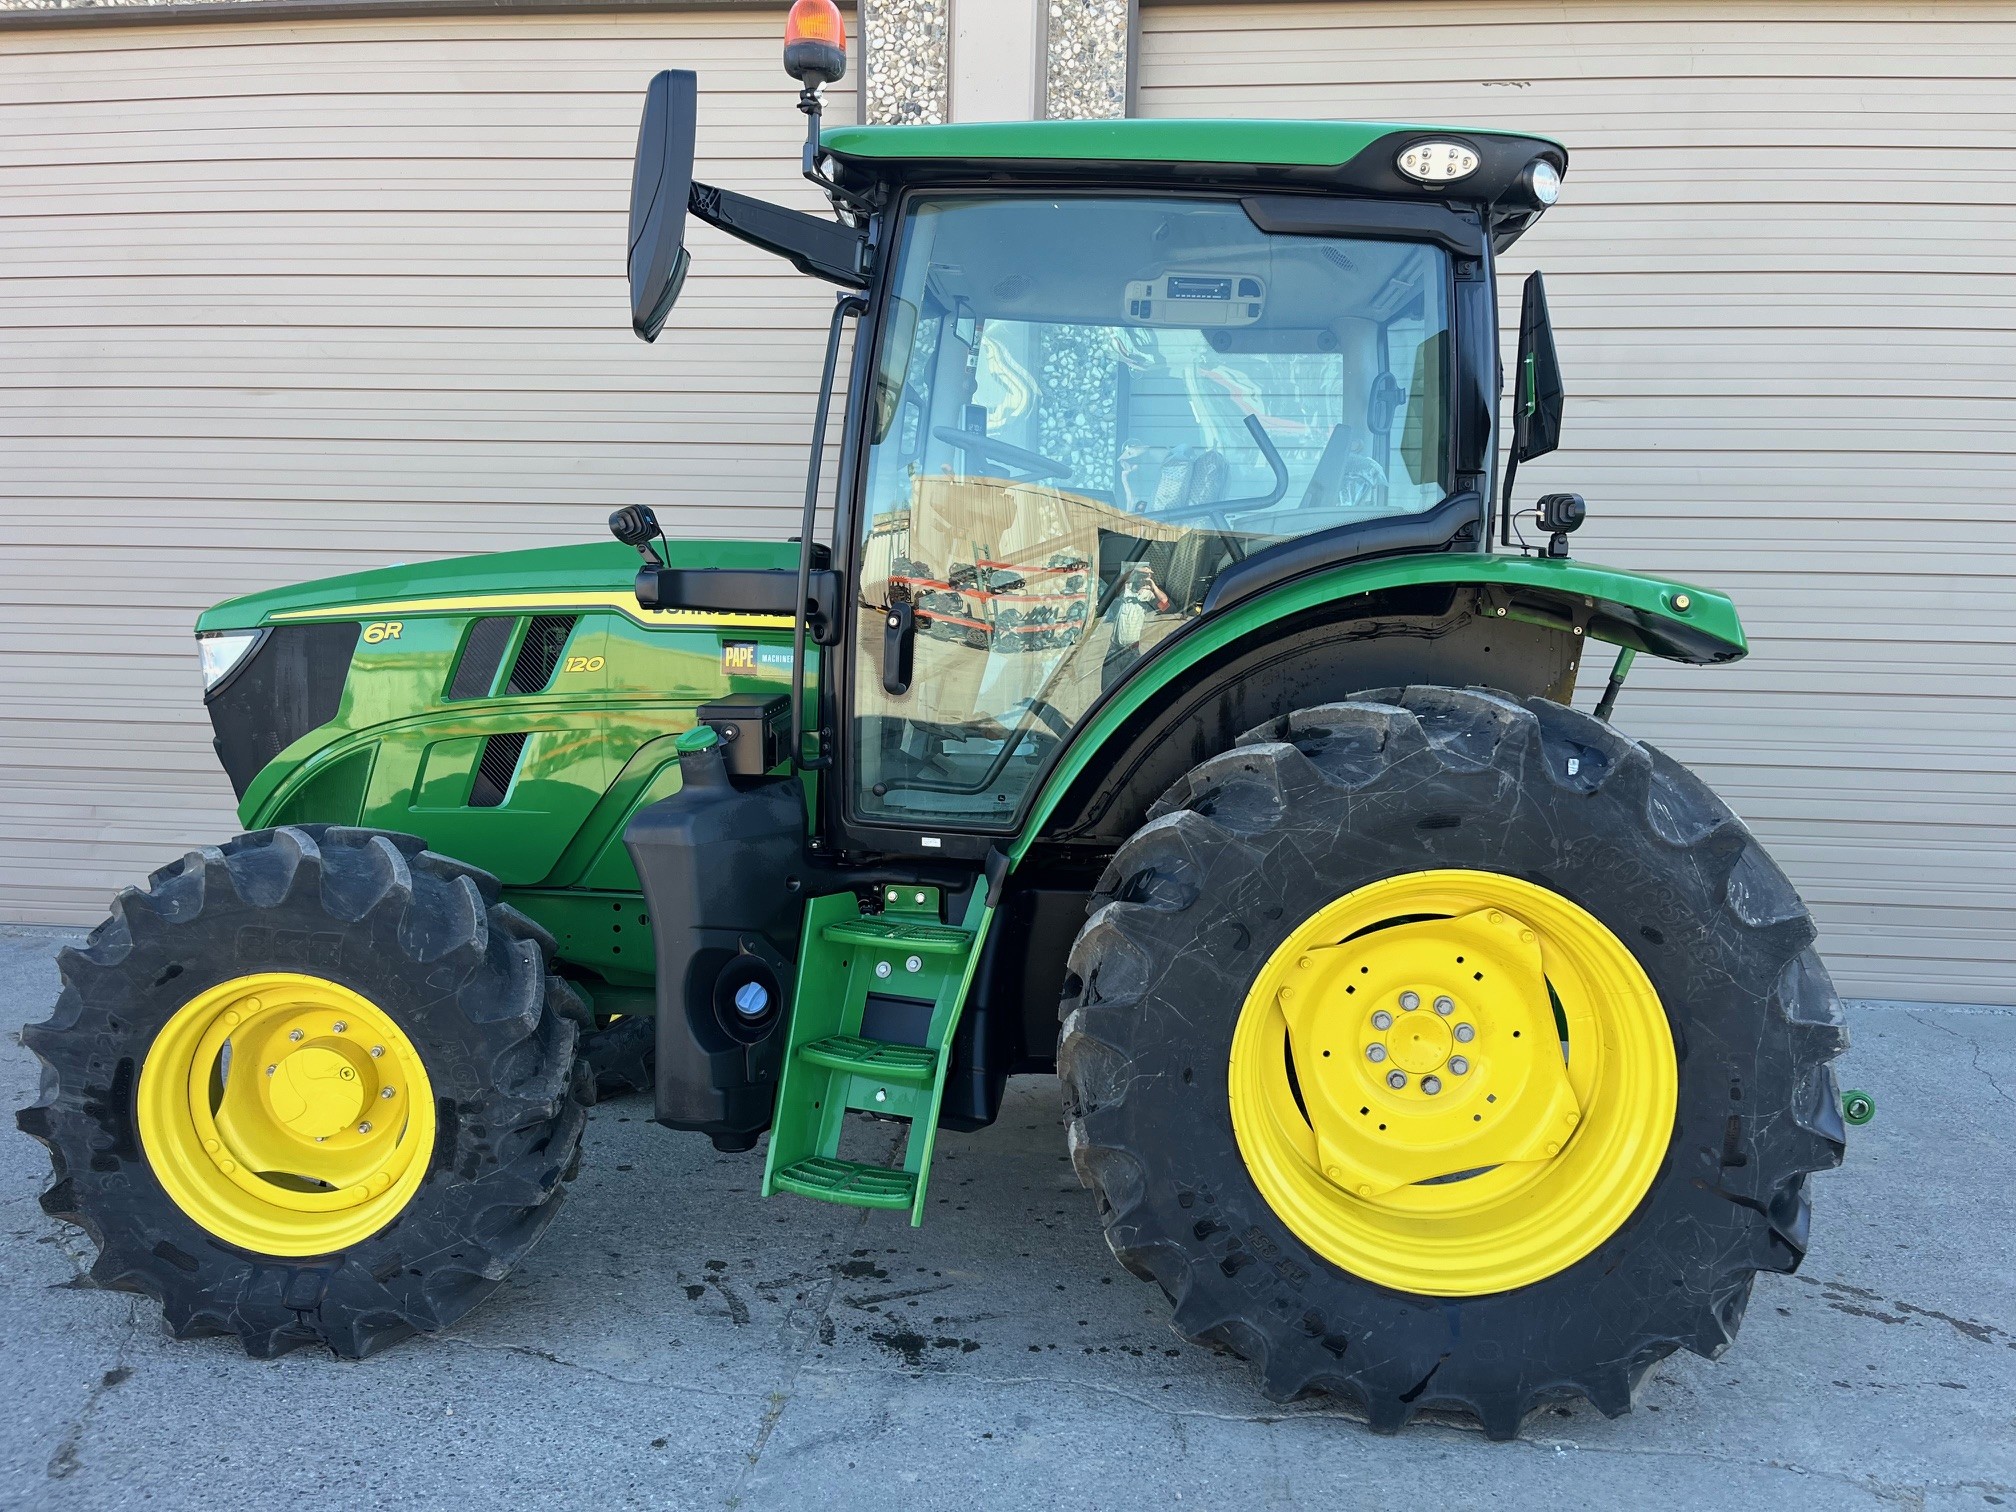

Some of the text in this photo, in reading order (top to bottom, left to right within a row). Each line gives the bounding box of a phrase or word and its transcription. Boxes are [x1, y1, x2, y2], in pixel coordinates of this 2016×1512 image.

[363, 621, 403, 644] 6R
[563, 655, 606, 673] 120
[761, 654, 794, 663] MACHINER
